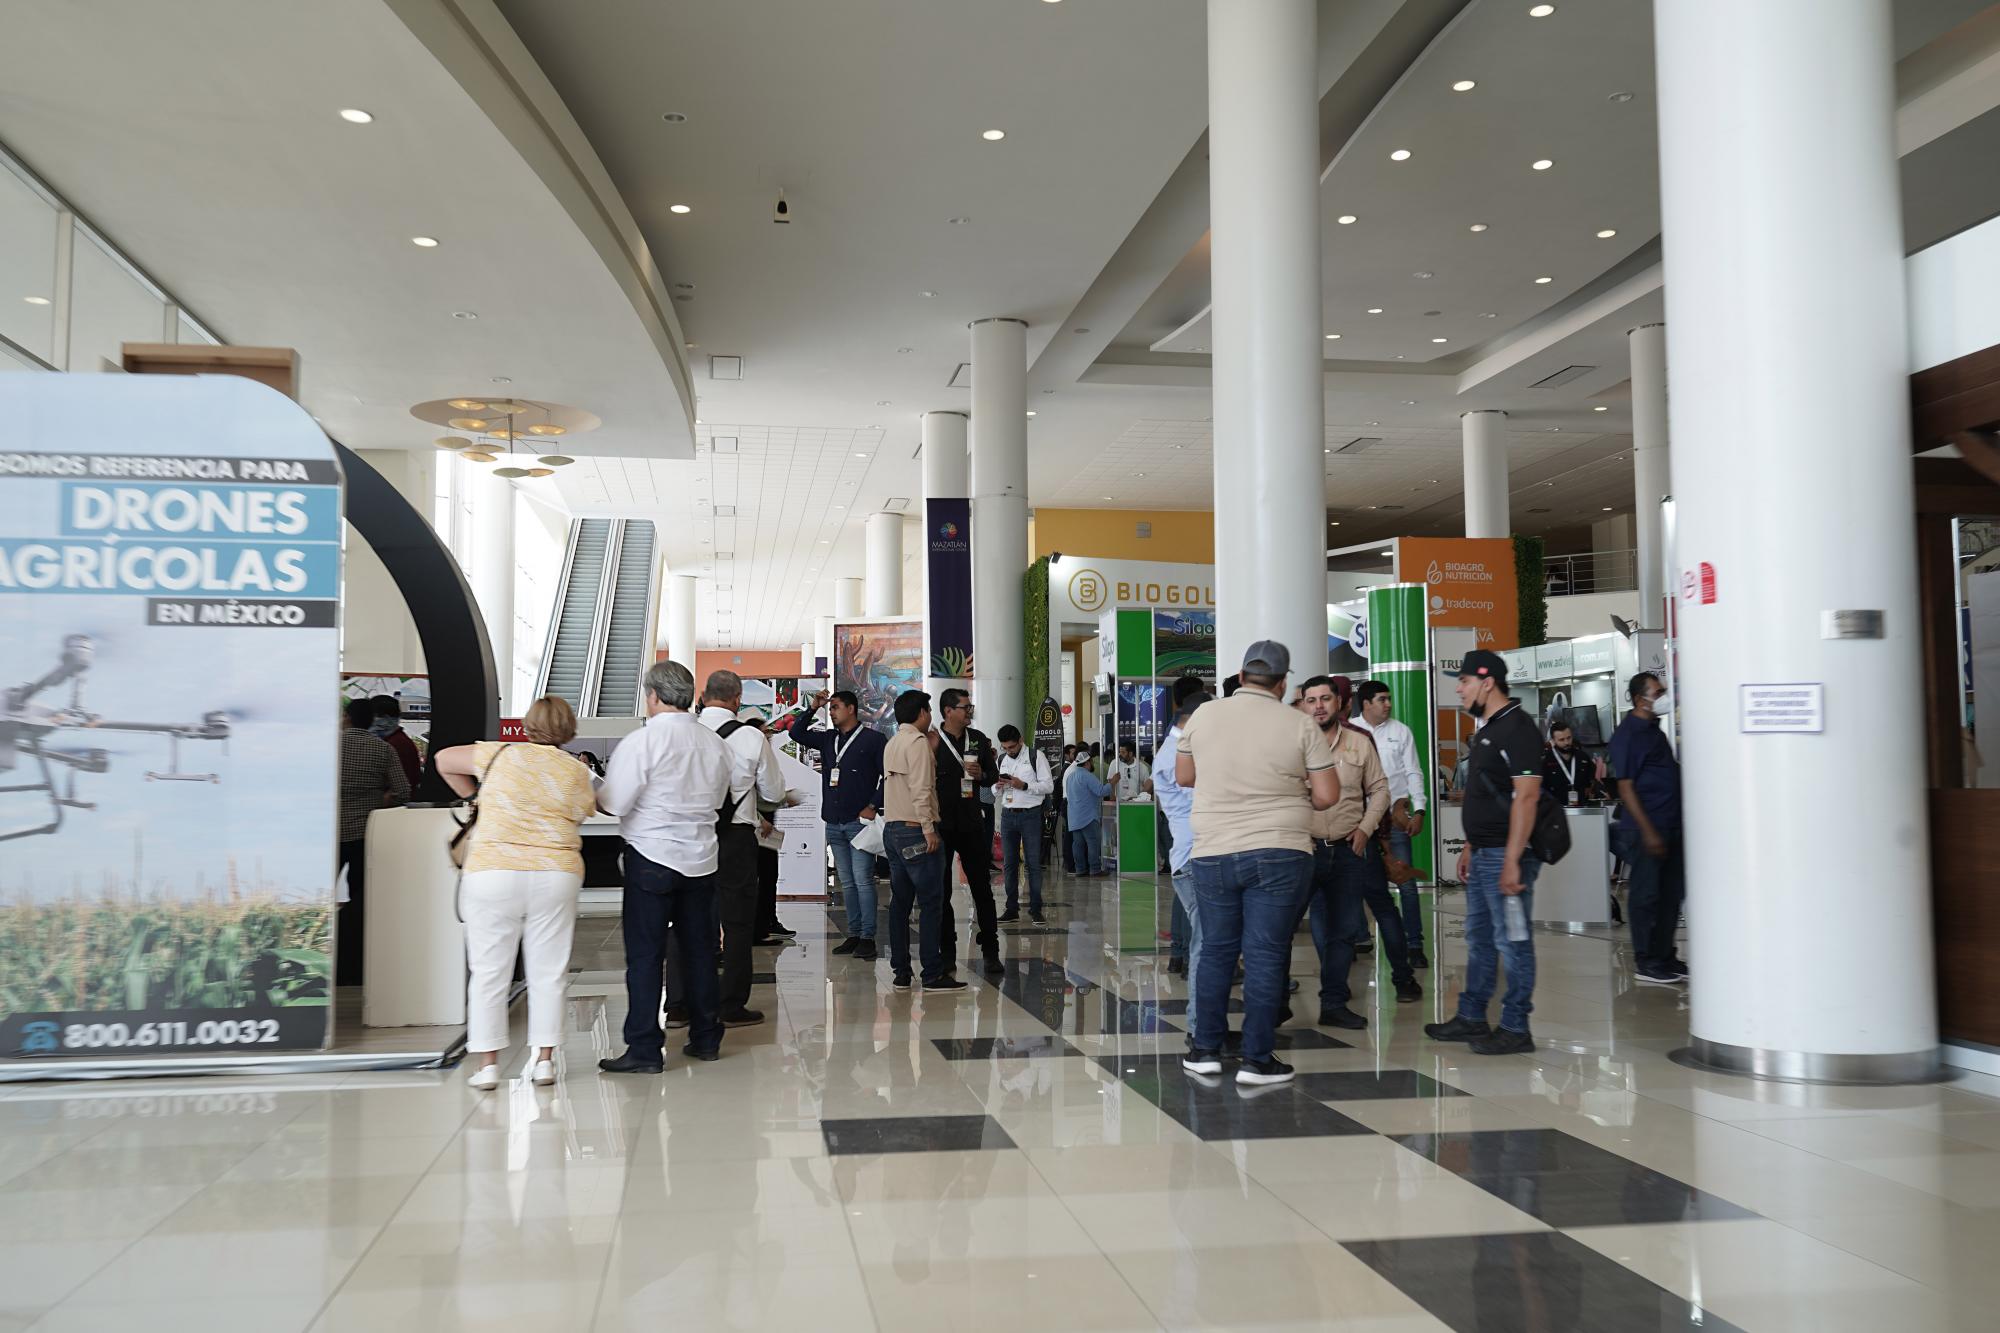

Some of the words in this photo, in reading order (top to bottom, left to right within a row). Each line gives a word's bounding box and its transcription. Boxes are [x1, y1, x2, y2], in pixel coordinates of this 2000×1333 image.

[89, 456, 235, 479] REFERENCIA
[239, 459, 309, 481] PARA
[72, 487, 309, 535] DRONES
[1445, 562, 1485, 572] BIOAGRO
[156, 603, 195, 623] EN
[200, 599, 306, 625] MÉXICO
[1446, 597, 1494, 613] tradecorp
[63, 1019, 280, 1049] 800.611.0032
